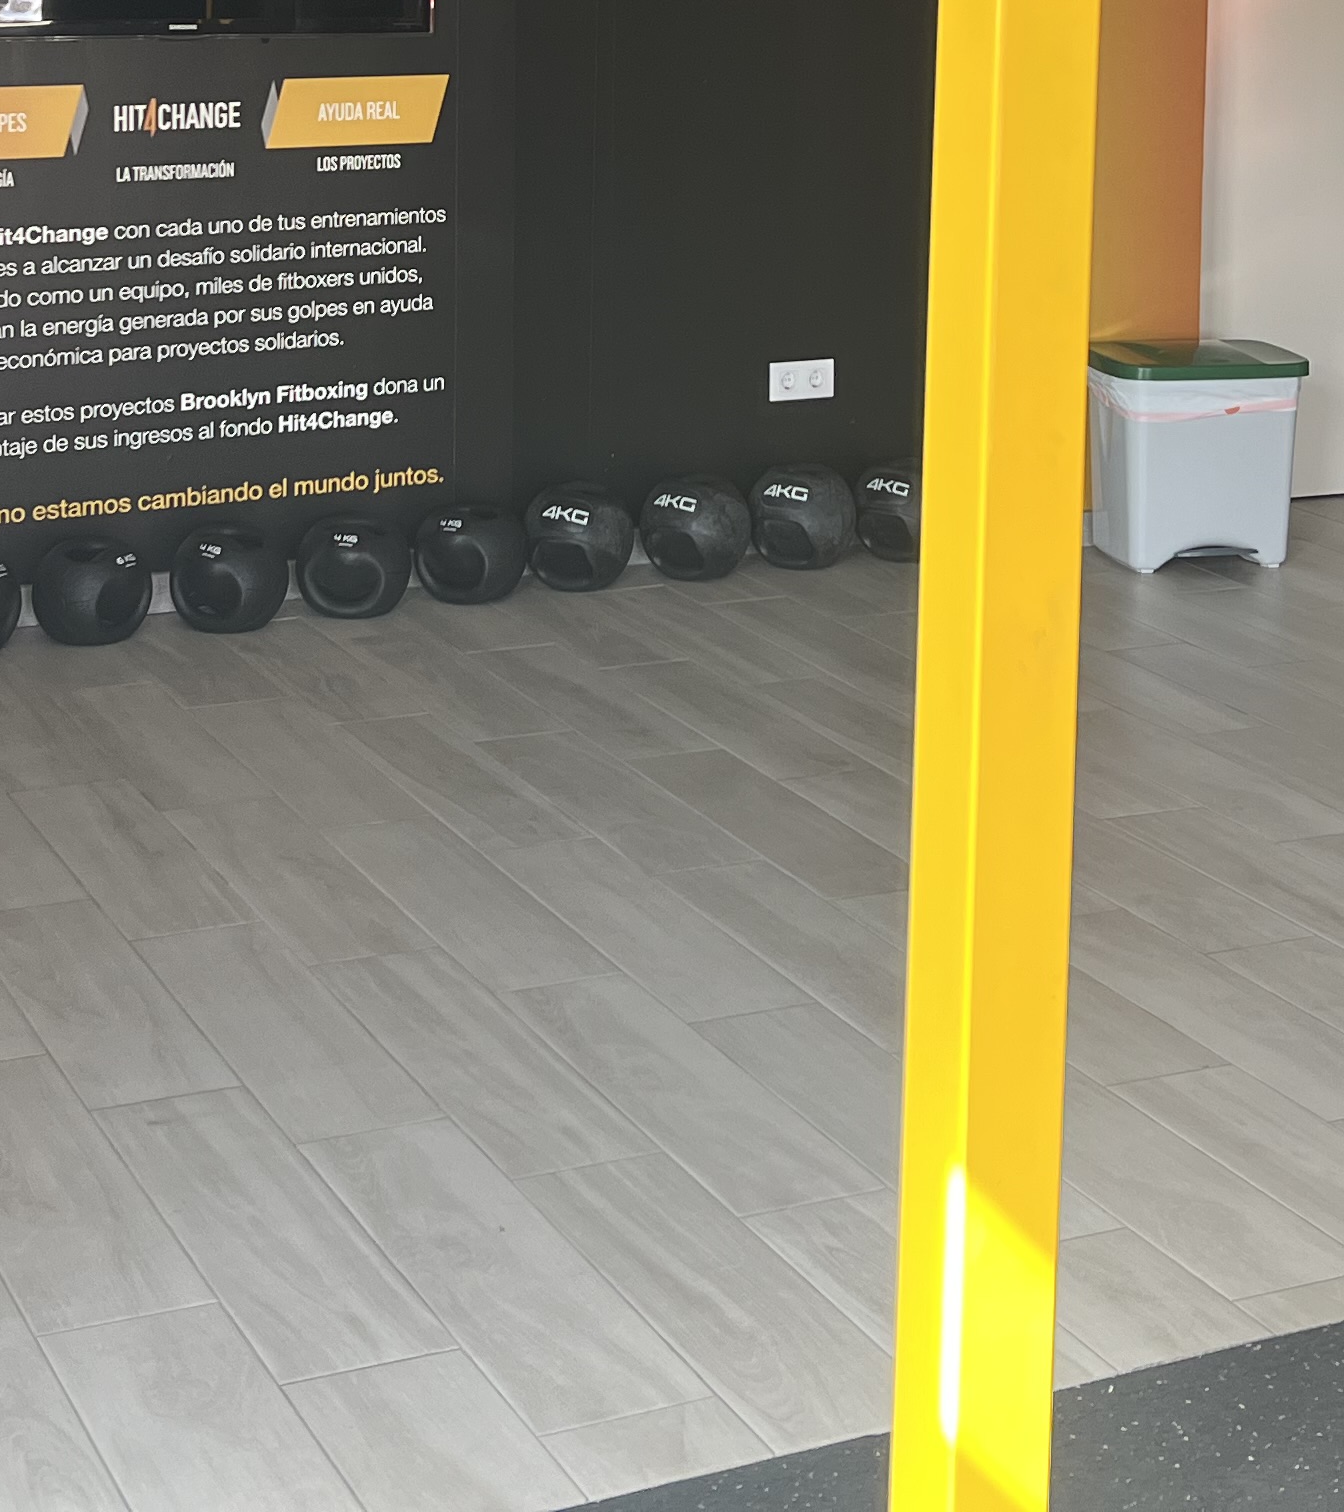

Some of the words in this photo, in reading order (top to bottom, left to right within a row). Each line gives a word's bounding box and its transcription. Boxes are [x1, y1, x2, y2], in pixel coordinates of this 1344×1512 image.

[113, 98, 241, 137] HIT4CHANGE
[318, 102, 363, 122] AYUDA
[367, 101, 400, 119] REAL
[116, 167, 131, 182] LA
[132, 160, 234, 181] TRANSFORMACIÓN
[317, 156, 338, 171] LOS
[340, 154, 401, 170] PROYECTOS
[114, 225, 150, 239] con
[156, 219, 203, 237] cada
[208, 220, 243, 234] uno
[249, 215, 272, 232] de
[277, 215, 306, 230] tus
[311, 208, 446, 229] entrenamientos
[23, 262, 36, 275] a
[41, 256, 123, 274] alcanzar
[128, 255, 151, 269] un
[157, 247, 224, 267] desafío
[230, 243, 305, 263] solidario
[311, 236, 426, 258] internacional.
[27, 290, 83, 306] como
[89, 288, 113, 302] un
[119, 281, 189, 303] equipo,
[196, 277, 243, 295] miles
[249, 274, 272, 292] de
[277, 272, 354, 290] fitboxers
[360, 266, 422, 285] unidos,
[21, 320, 37, 337] la
[43, 314, 114, 337] energía
[119, 309, 208, 334] generada
[214, 309, 246, 328] por
[251, 307, 282, 322] sus
[288, 301, 348, 323] golpes
[353, 301, 374, 315] en
[380, 294, 433, 316] ayuda
[109, 346, 152, 366] para
[157, 337, 249, 362] proyectos
[255, 330, 344, 351] solidarios.
[21, 405, 74, 423] estos
[81, 397, 174, 423] proyectos
[181, 389, 270, 411] Brooklyn
[277, 381, 368, 403] Fitboxing
[374, 378, 418, 395] dona
[424, 377, 444, 391] un
[43, 435, 68, 452] de
[74, 435, 108, 450] sus
[114, 427, 193, 449] ingresos
[199, 421, 214, 440] al
[219, 417, 272, 438] fondo
[279, 411, 398, 433] Hit4Change.
[33, 498, 131, 520] estamos
[138, 482, 262, 510] cambiando
[269, 478, 287, 498] el
[294, 471, 368, 496] mundo
[374, 467, 443, 493] juntos.
[654, 495, 697, 512] 4KG
[764, 485, 808, 501] 4KG
[867, 479, 909, 496] 4KG
[543, 506, 589, 525] 4KG
